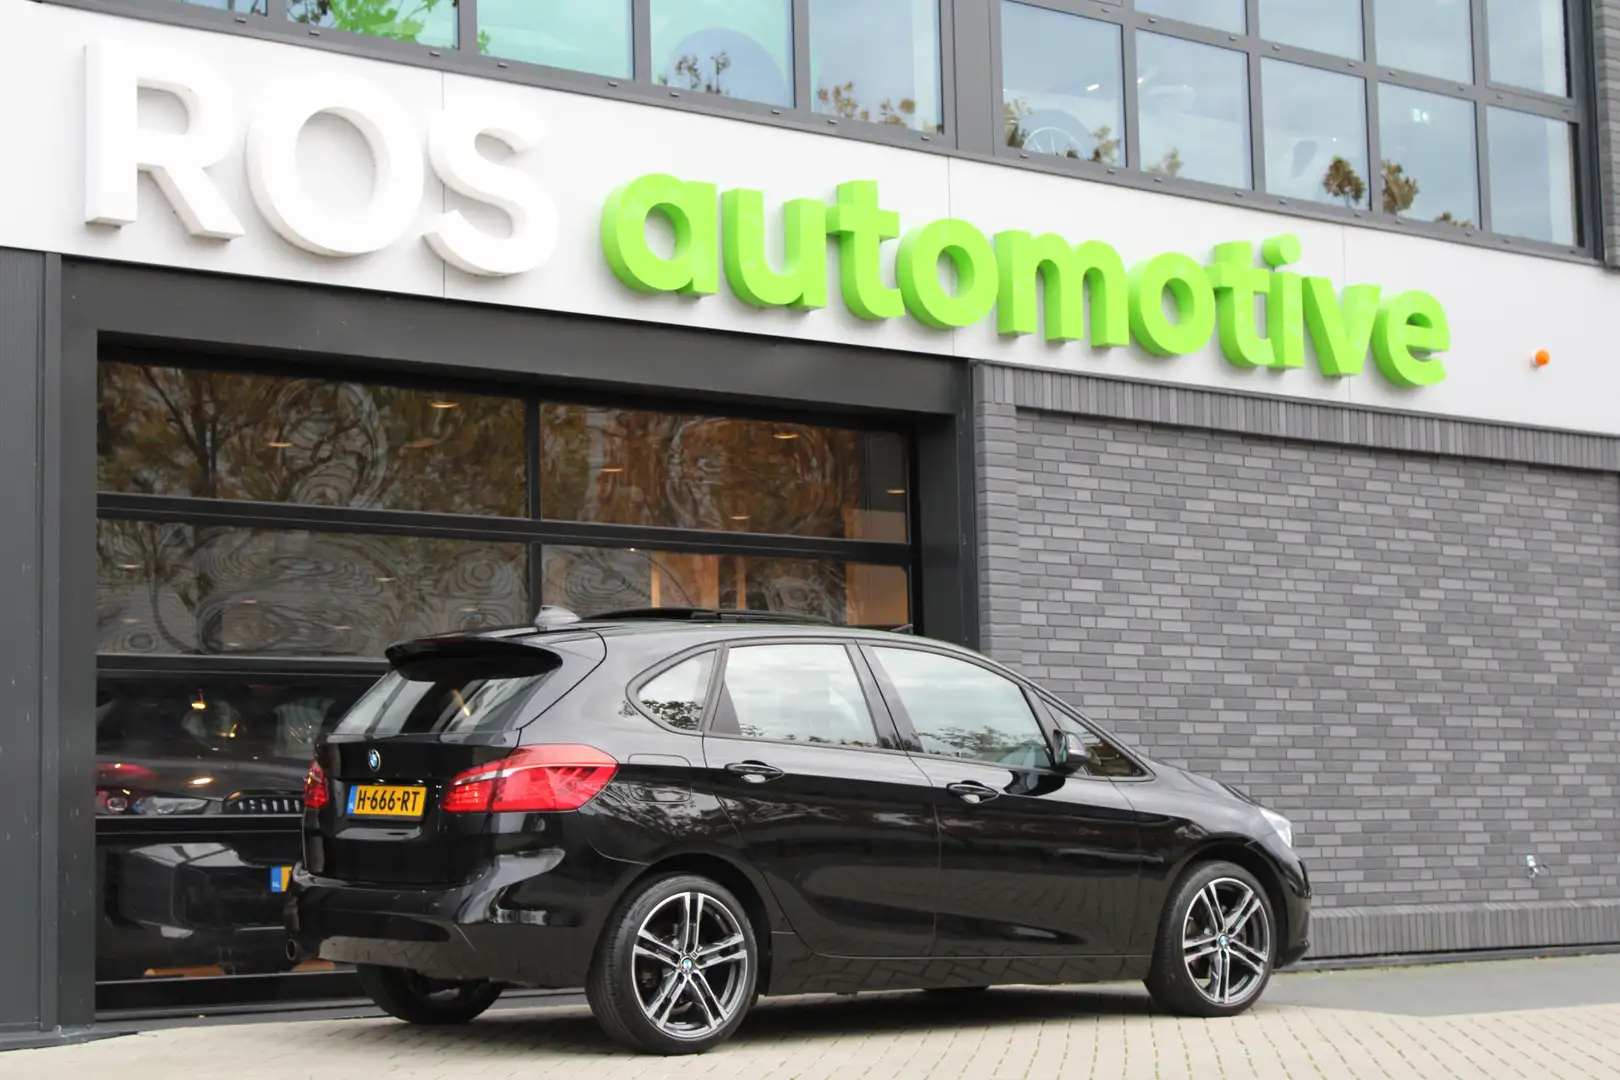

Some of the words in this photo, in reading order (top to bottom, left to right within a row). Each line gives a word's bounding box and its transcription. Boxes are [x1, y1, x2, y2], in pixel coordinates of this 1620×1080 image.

[84, 39, 559, 275] ROS
[601, 173, 1451, 388] automotive
[357, 790, 420, 812] H-666-RT
